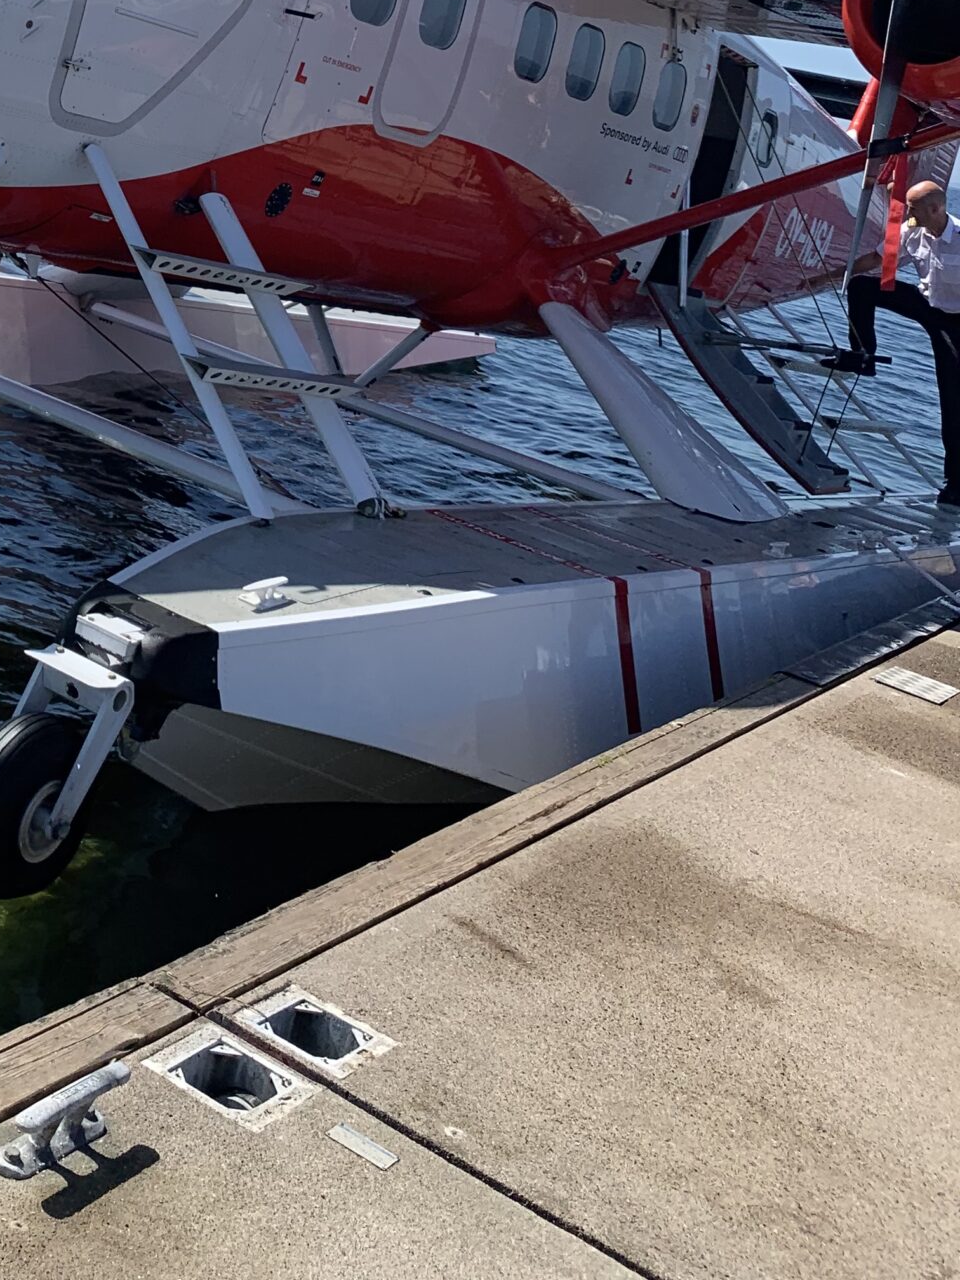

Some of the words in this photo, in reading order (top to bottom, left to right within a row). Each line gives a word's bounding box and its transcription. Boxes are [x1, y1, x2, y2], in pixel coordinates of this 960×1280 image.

[600, 123, 641, 145] Sponsored
[642, 137, 651, 151] by
[652, 141, 670, 155] Audi
